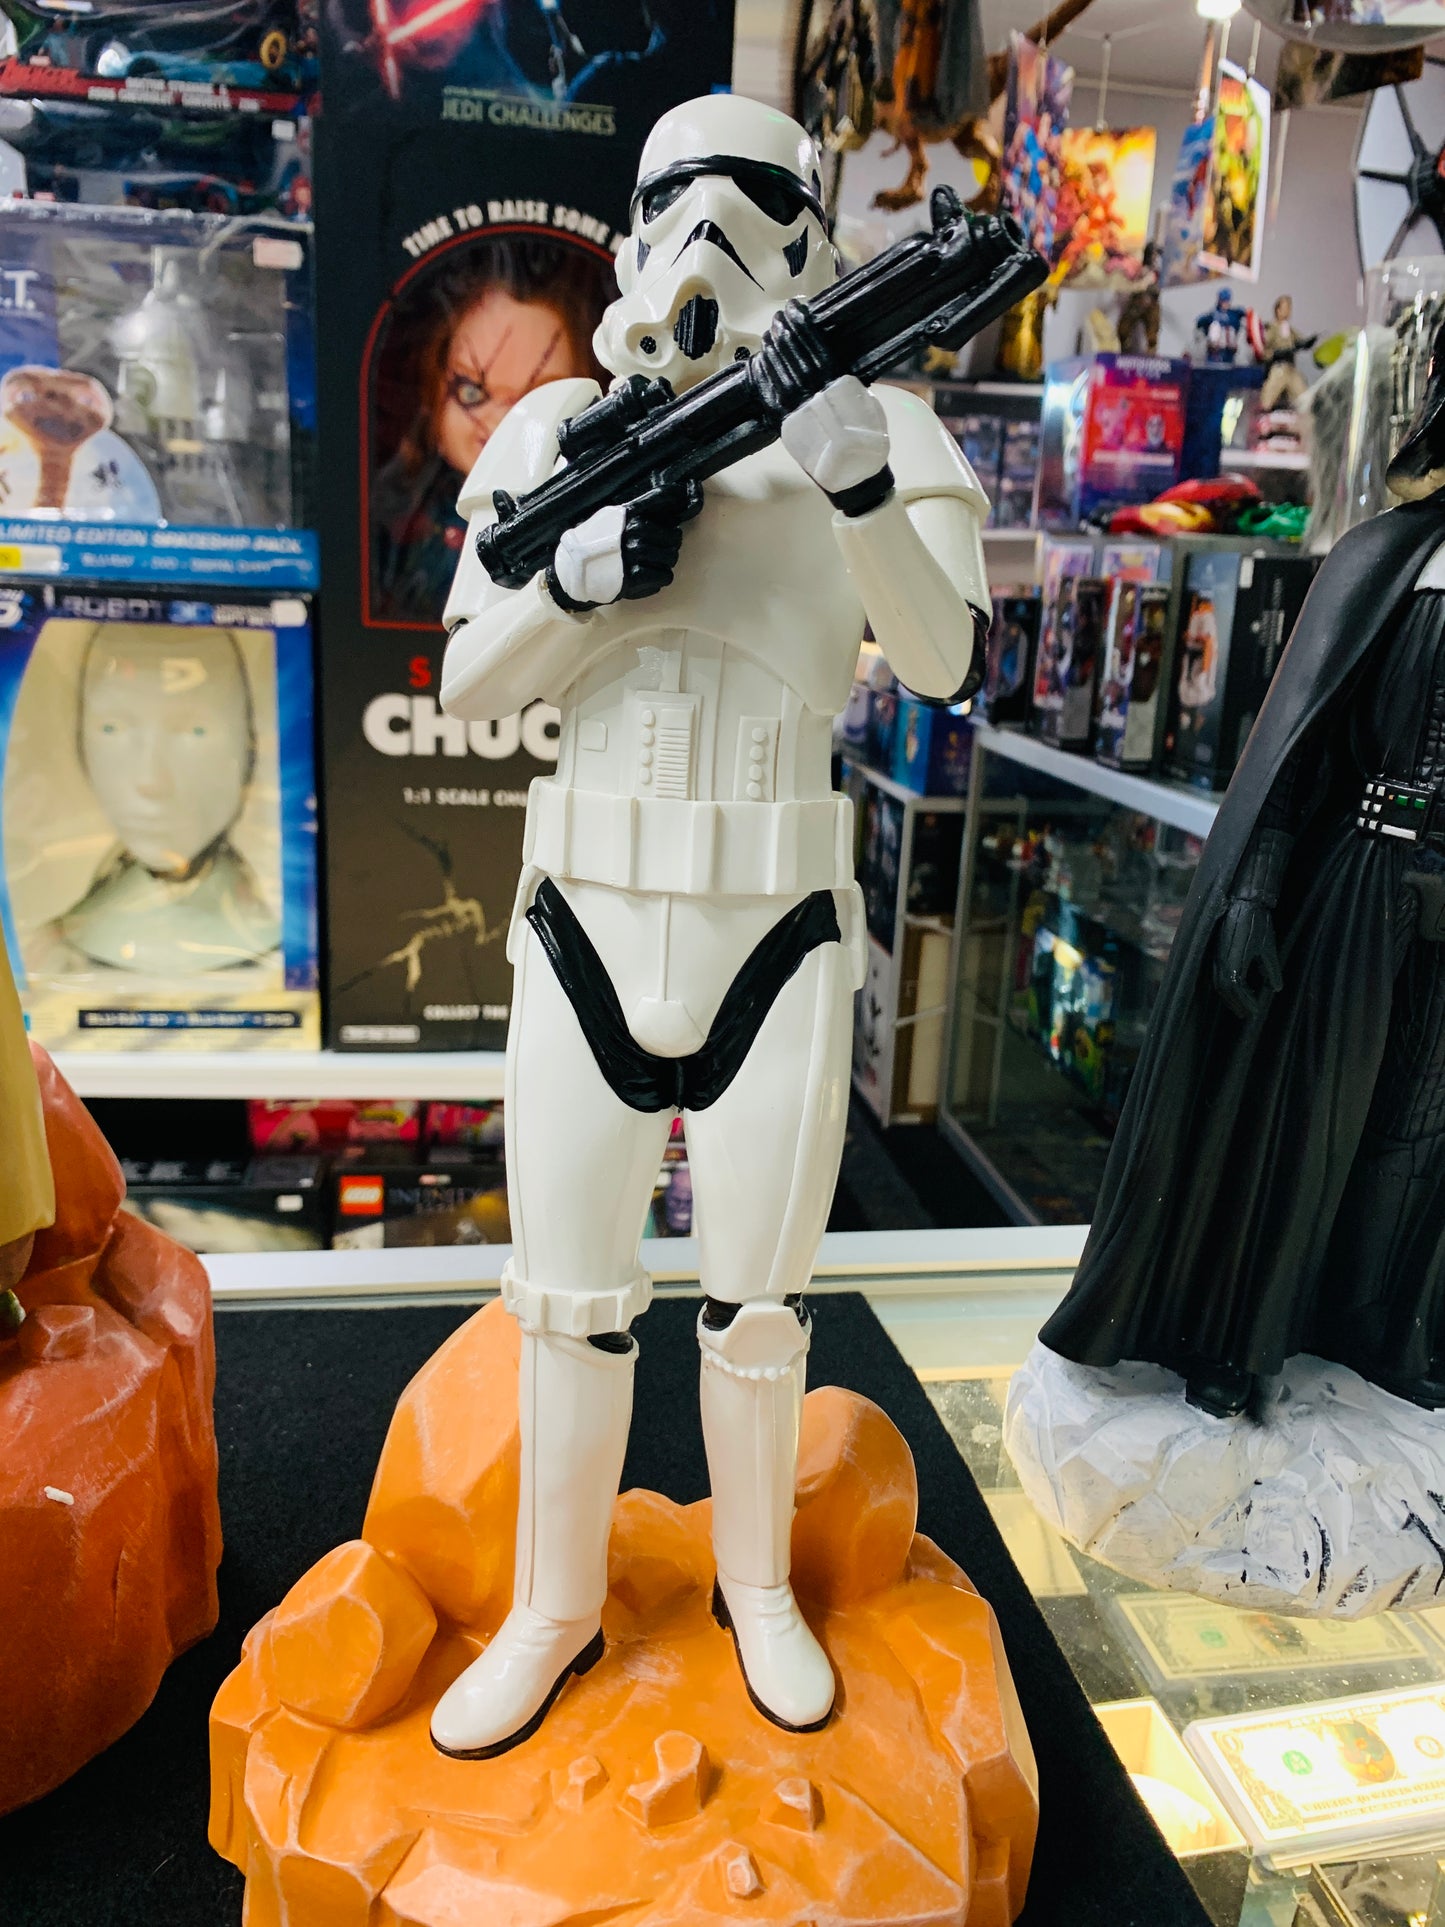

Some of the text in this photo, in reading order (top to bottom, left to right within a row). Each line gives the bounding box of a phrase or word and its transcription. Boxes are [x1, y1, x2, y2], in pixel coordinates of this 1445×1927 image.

[441, 97, 616, 136] JEDI CHALLENGES
[402, 215, 454, 257] TIME
[453, 204, 484, 231] TO
[487, 200, 549, 224] RAISE
[552, 204, 610, 246] SOME
[0, 522, 302, 555] LIMITED EDITION SPACESHIP PACK
[435, 788, 490, 806] SCALE
[422, 1003, 480, 1021] COLLECT
